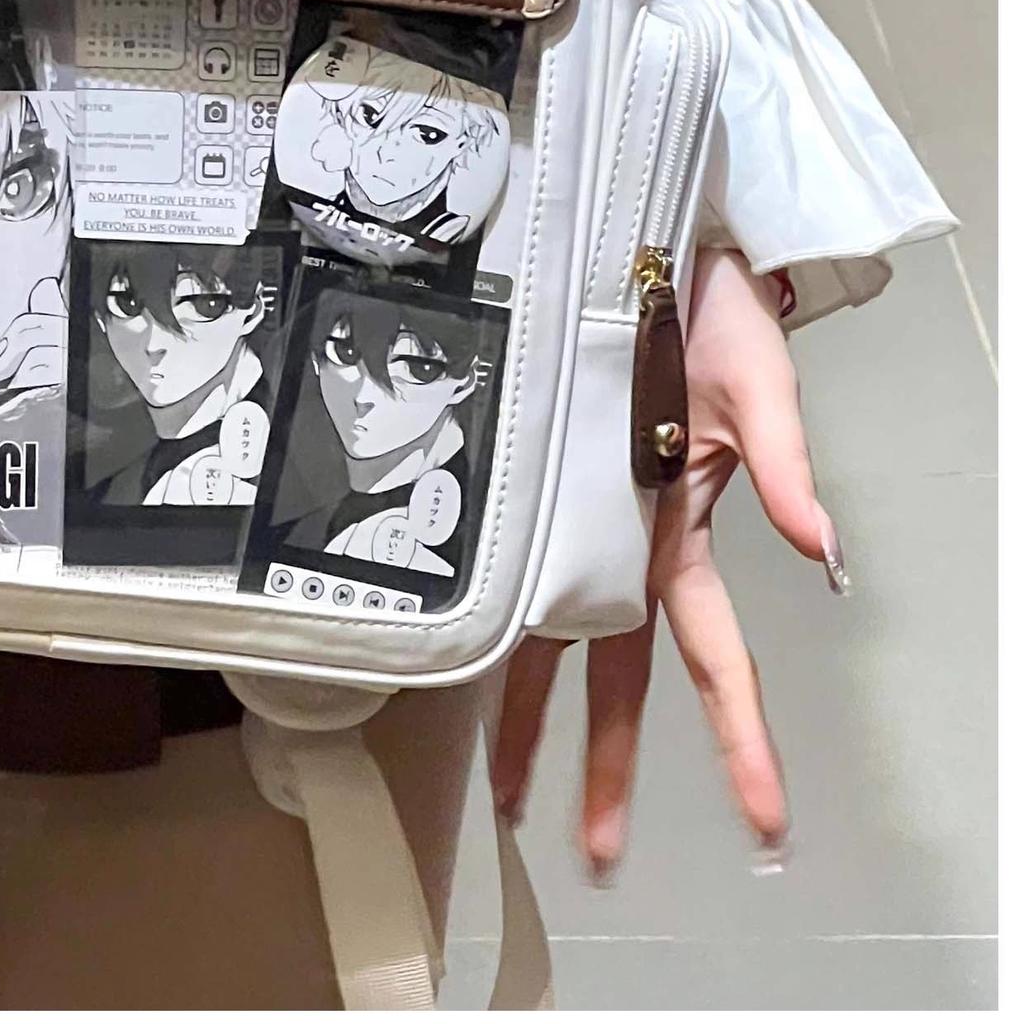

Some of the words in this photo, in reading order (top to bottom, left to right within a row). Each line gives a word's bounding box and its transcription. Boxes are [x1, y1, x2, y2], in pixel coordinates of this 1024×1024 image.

[88, 191, 105, 202] NO
[107, 193, 148, 205] MATTER
[149, 195, 176, 206] HOW
[177, 196, 197, 207] LIFE
[199, 197, 236, 209] TREATS
[150, 209, 162, 219] BE
[83, 220, 135, 232] EVERYONE
[137, 223, 147, 233] IS
[149, 224, 166, 234] HIS
[167, 225, 195, 235] OWN
[311, 201, 416, 253] ブルーロック
